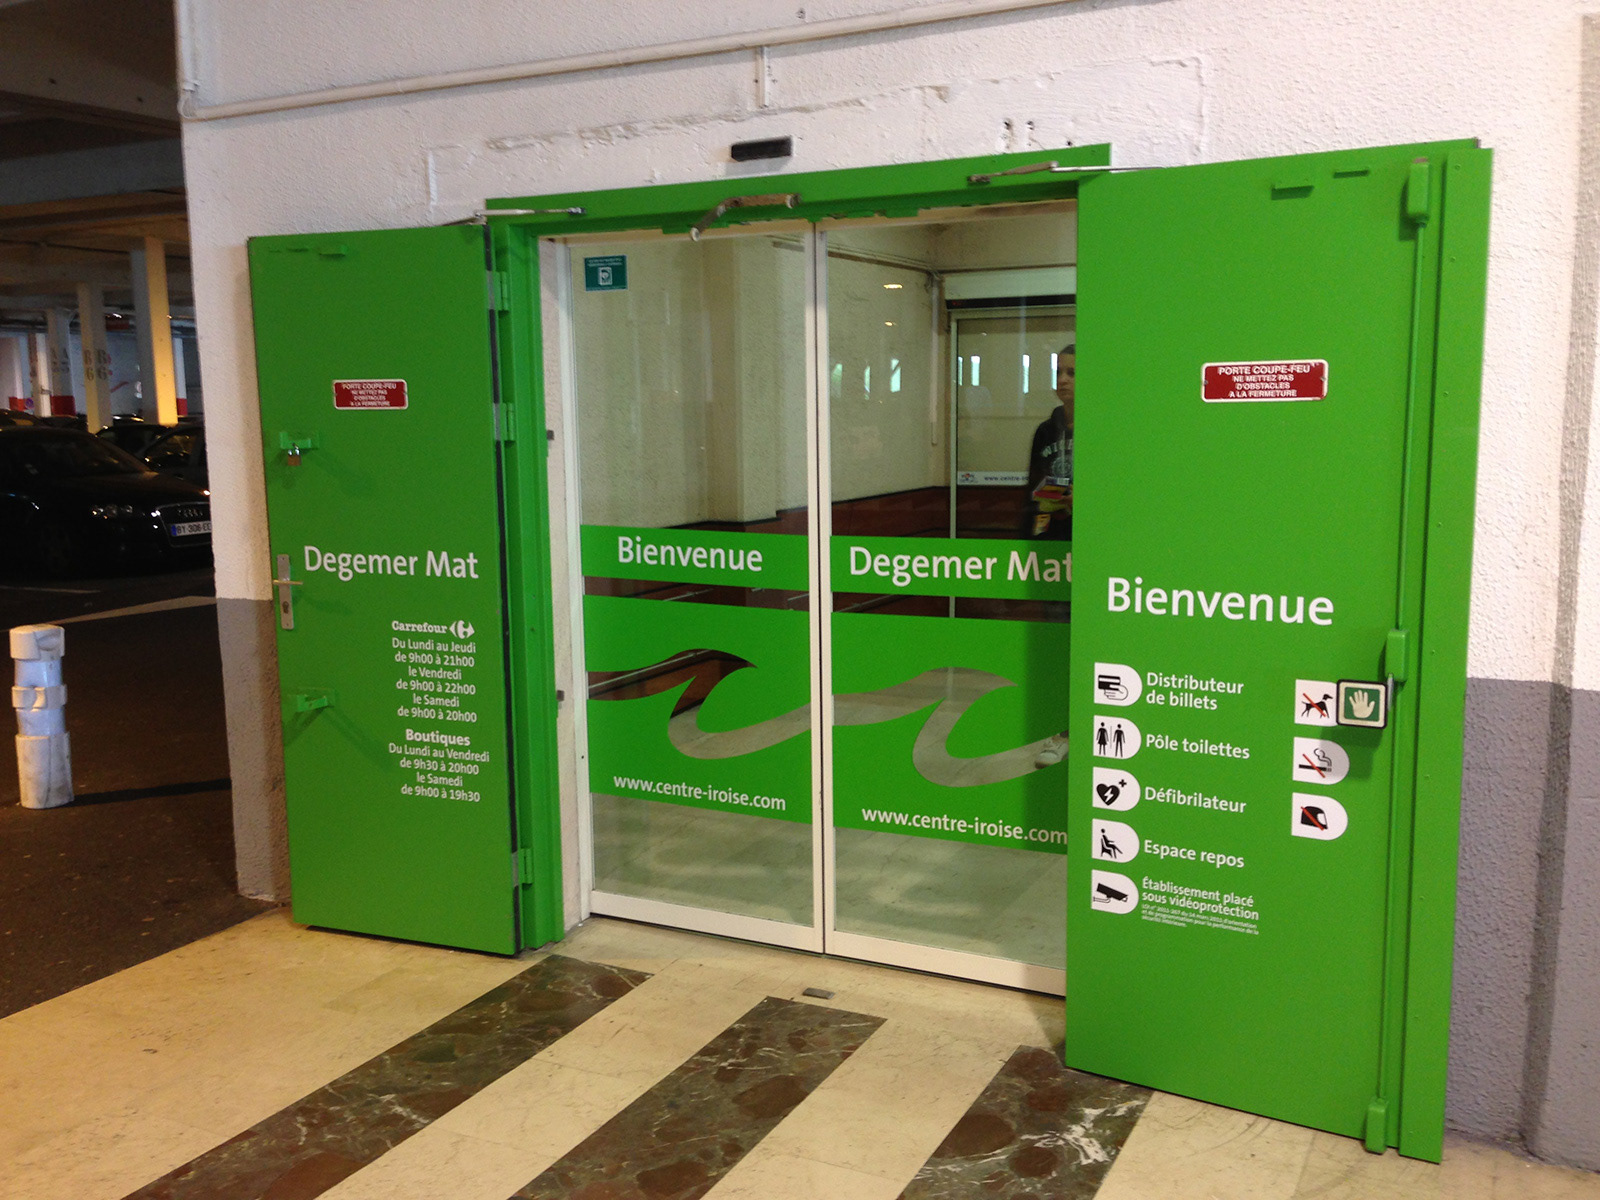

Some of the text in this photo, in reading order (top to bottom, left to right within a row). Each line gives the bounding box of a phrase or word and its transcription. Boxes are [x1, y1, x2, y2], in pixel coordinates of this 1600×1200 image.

[1218, 364, 1311, 376] PORTE COUPE-FEU
[1246, 374, 1277, 382] METTEZ
[1236, 381, 1290, 390] D'OBSTACLES
[1237, 390, 1247, 398] LA
[1249, 389, 1297, 398] FERMETURE
[304, 545, 479, 582] Degemer Mat
[618, 536, 763, 572] Bienvenue
[850, 546, 1072, 587] Degemer Mat
[1107, 576, 1334, 626] Bienvenue
[392, 620, 448, 634] Carrefour
[391, 637, 476, 654] Du Lundi au Jeudi
[394, 651, 475, 668] de 9h00 à 21h00
[408, 665, 462, 680] le Vendredi
[396, 678, 476, 695] de 9h00 à 22h00
[1146, 672, 1244, 694] Distributeur
[412, 693, 460, 708] le Samedi
[1146, 689, 1218, 710] de billets
[397, 706, 478, 723] de 9h00 à 20h00
[405, 728, 471, 747] Boutiques
[1146, 734, 1250, 760] Pôle toilettes
[388, 743, 490, 763] Du Lundi au Vendredi
[399, 756, 480, 775] de 9h30 à 20h00
[416, 771, 463, 787] le Samedi
[401, 783, 481, 802] de 9h00 à 19h30
[613, 774, 786, 812] www.centre-iroise.com
[1144, 786, 1246, 814] Défibrilateur
[861, 806, 1068, 845] www.centre-iroise.com
[1144, 839, 1245, 869] Espace repos
[1142, 875, 1254, 908] Établissement placé
[1142, 892, 1259, 921] sous vidéoprotection
